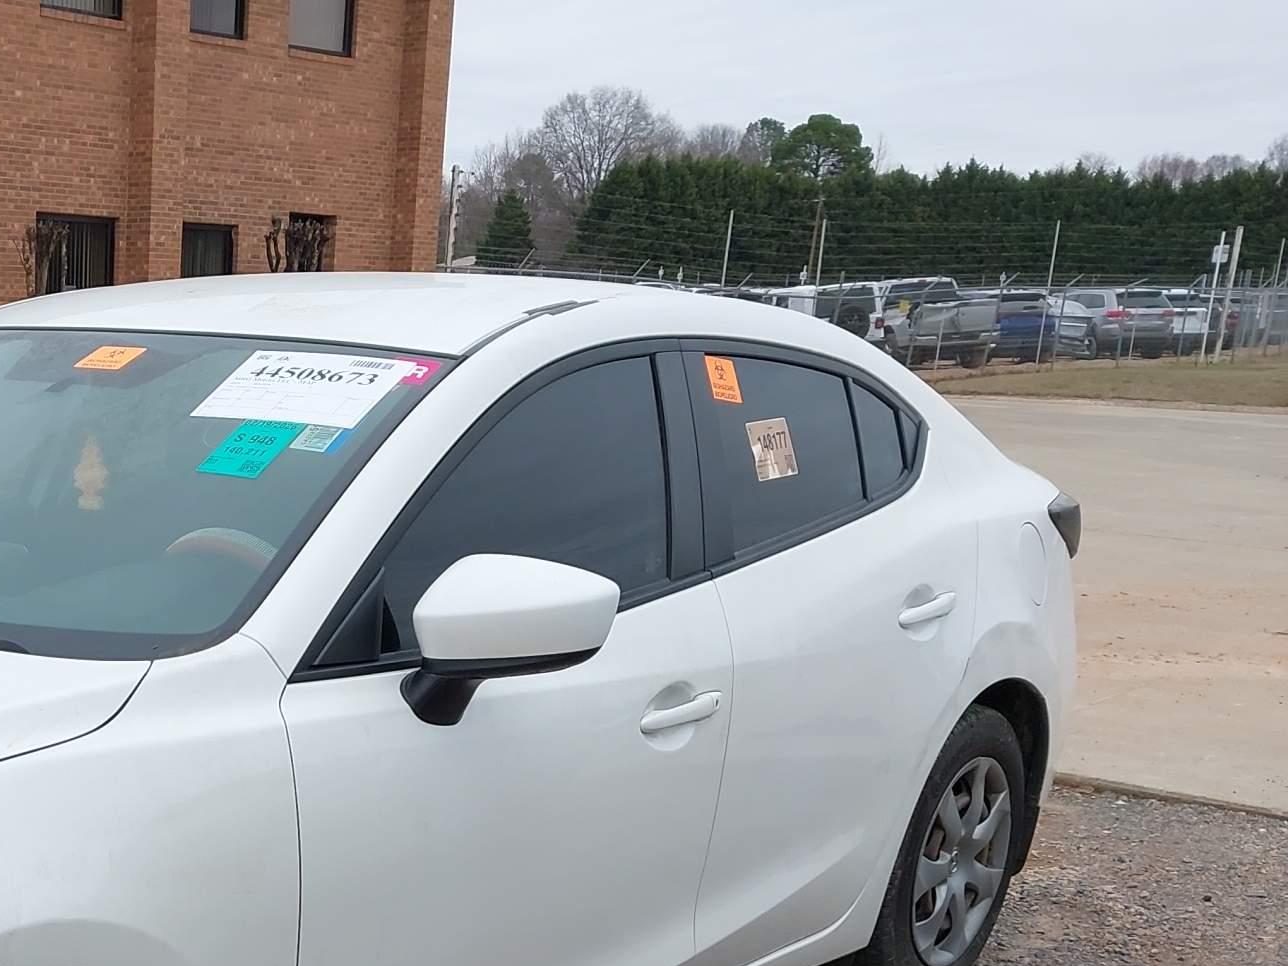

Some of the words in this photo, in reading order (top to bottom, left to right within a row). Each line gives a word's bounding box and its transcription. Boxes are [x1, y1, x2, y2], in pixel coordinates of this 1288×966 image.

[250, 365, 379, 386] 44508673
[234, 433, 247, 442] S
[757, 431, 787, 451] 148177
